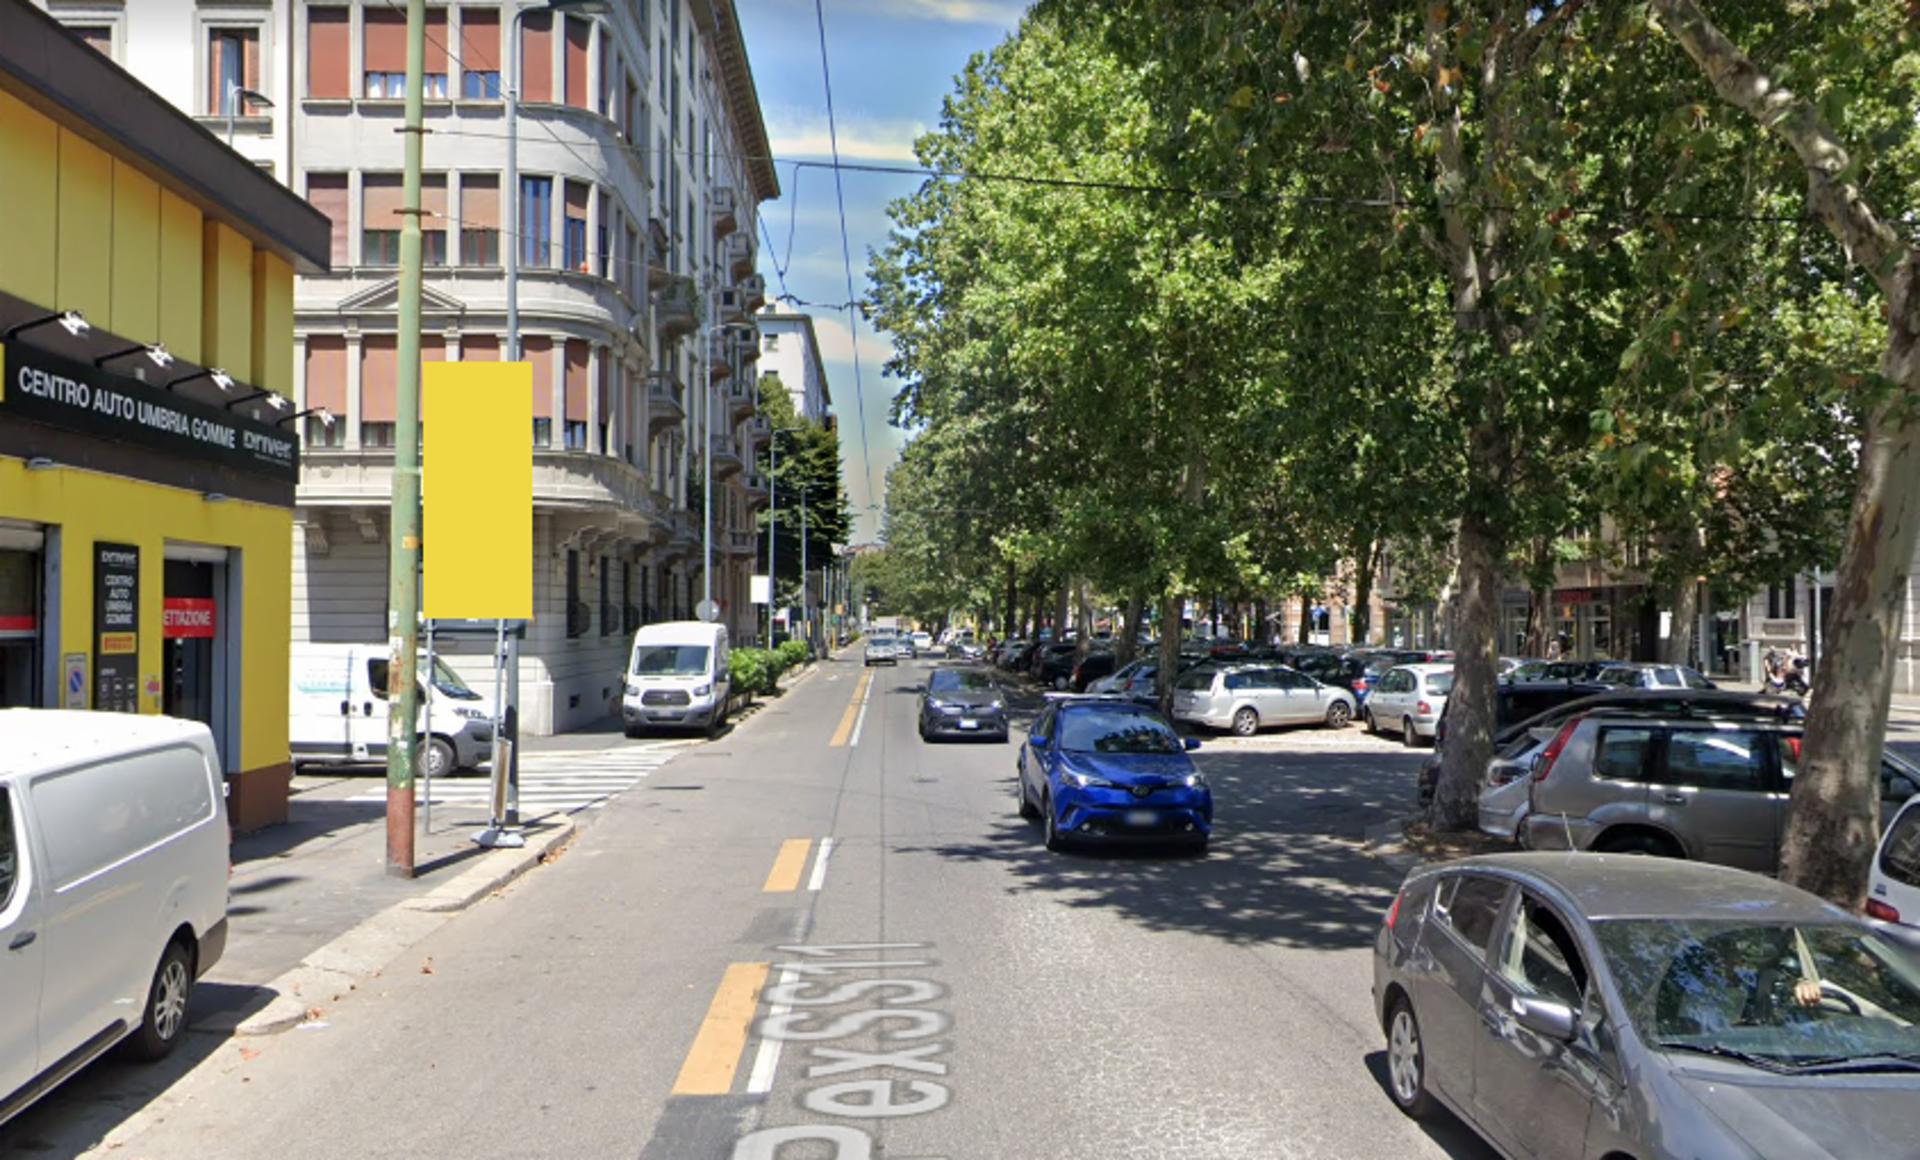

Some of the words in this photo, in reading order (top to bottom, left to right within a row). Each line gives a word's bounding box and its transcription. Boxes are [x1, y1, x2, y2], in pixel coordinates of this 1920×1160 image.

[18, 366, 90, 408] CENTRO
[92, 388, 135, 420] AUTO
[137, 400, 190, 437] UMBRIA
[191, 417, 236, 449] GOMME
[104, 574, 135, 588] CENTRO
[109, 588, 130, 599] AUTO
